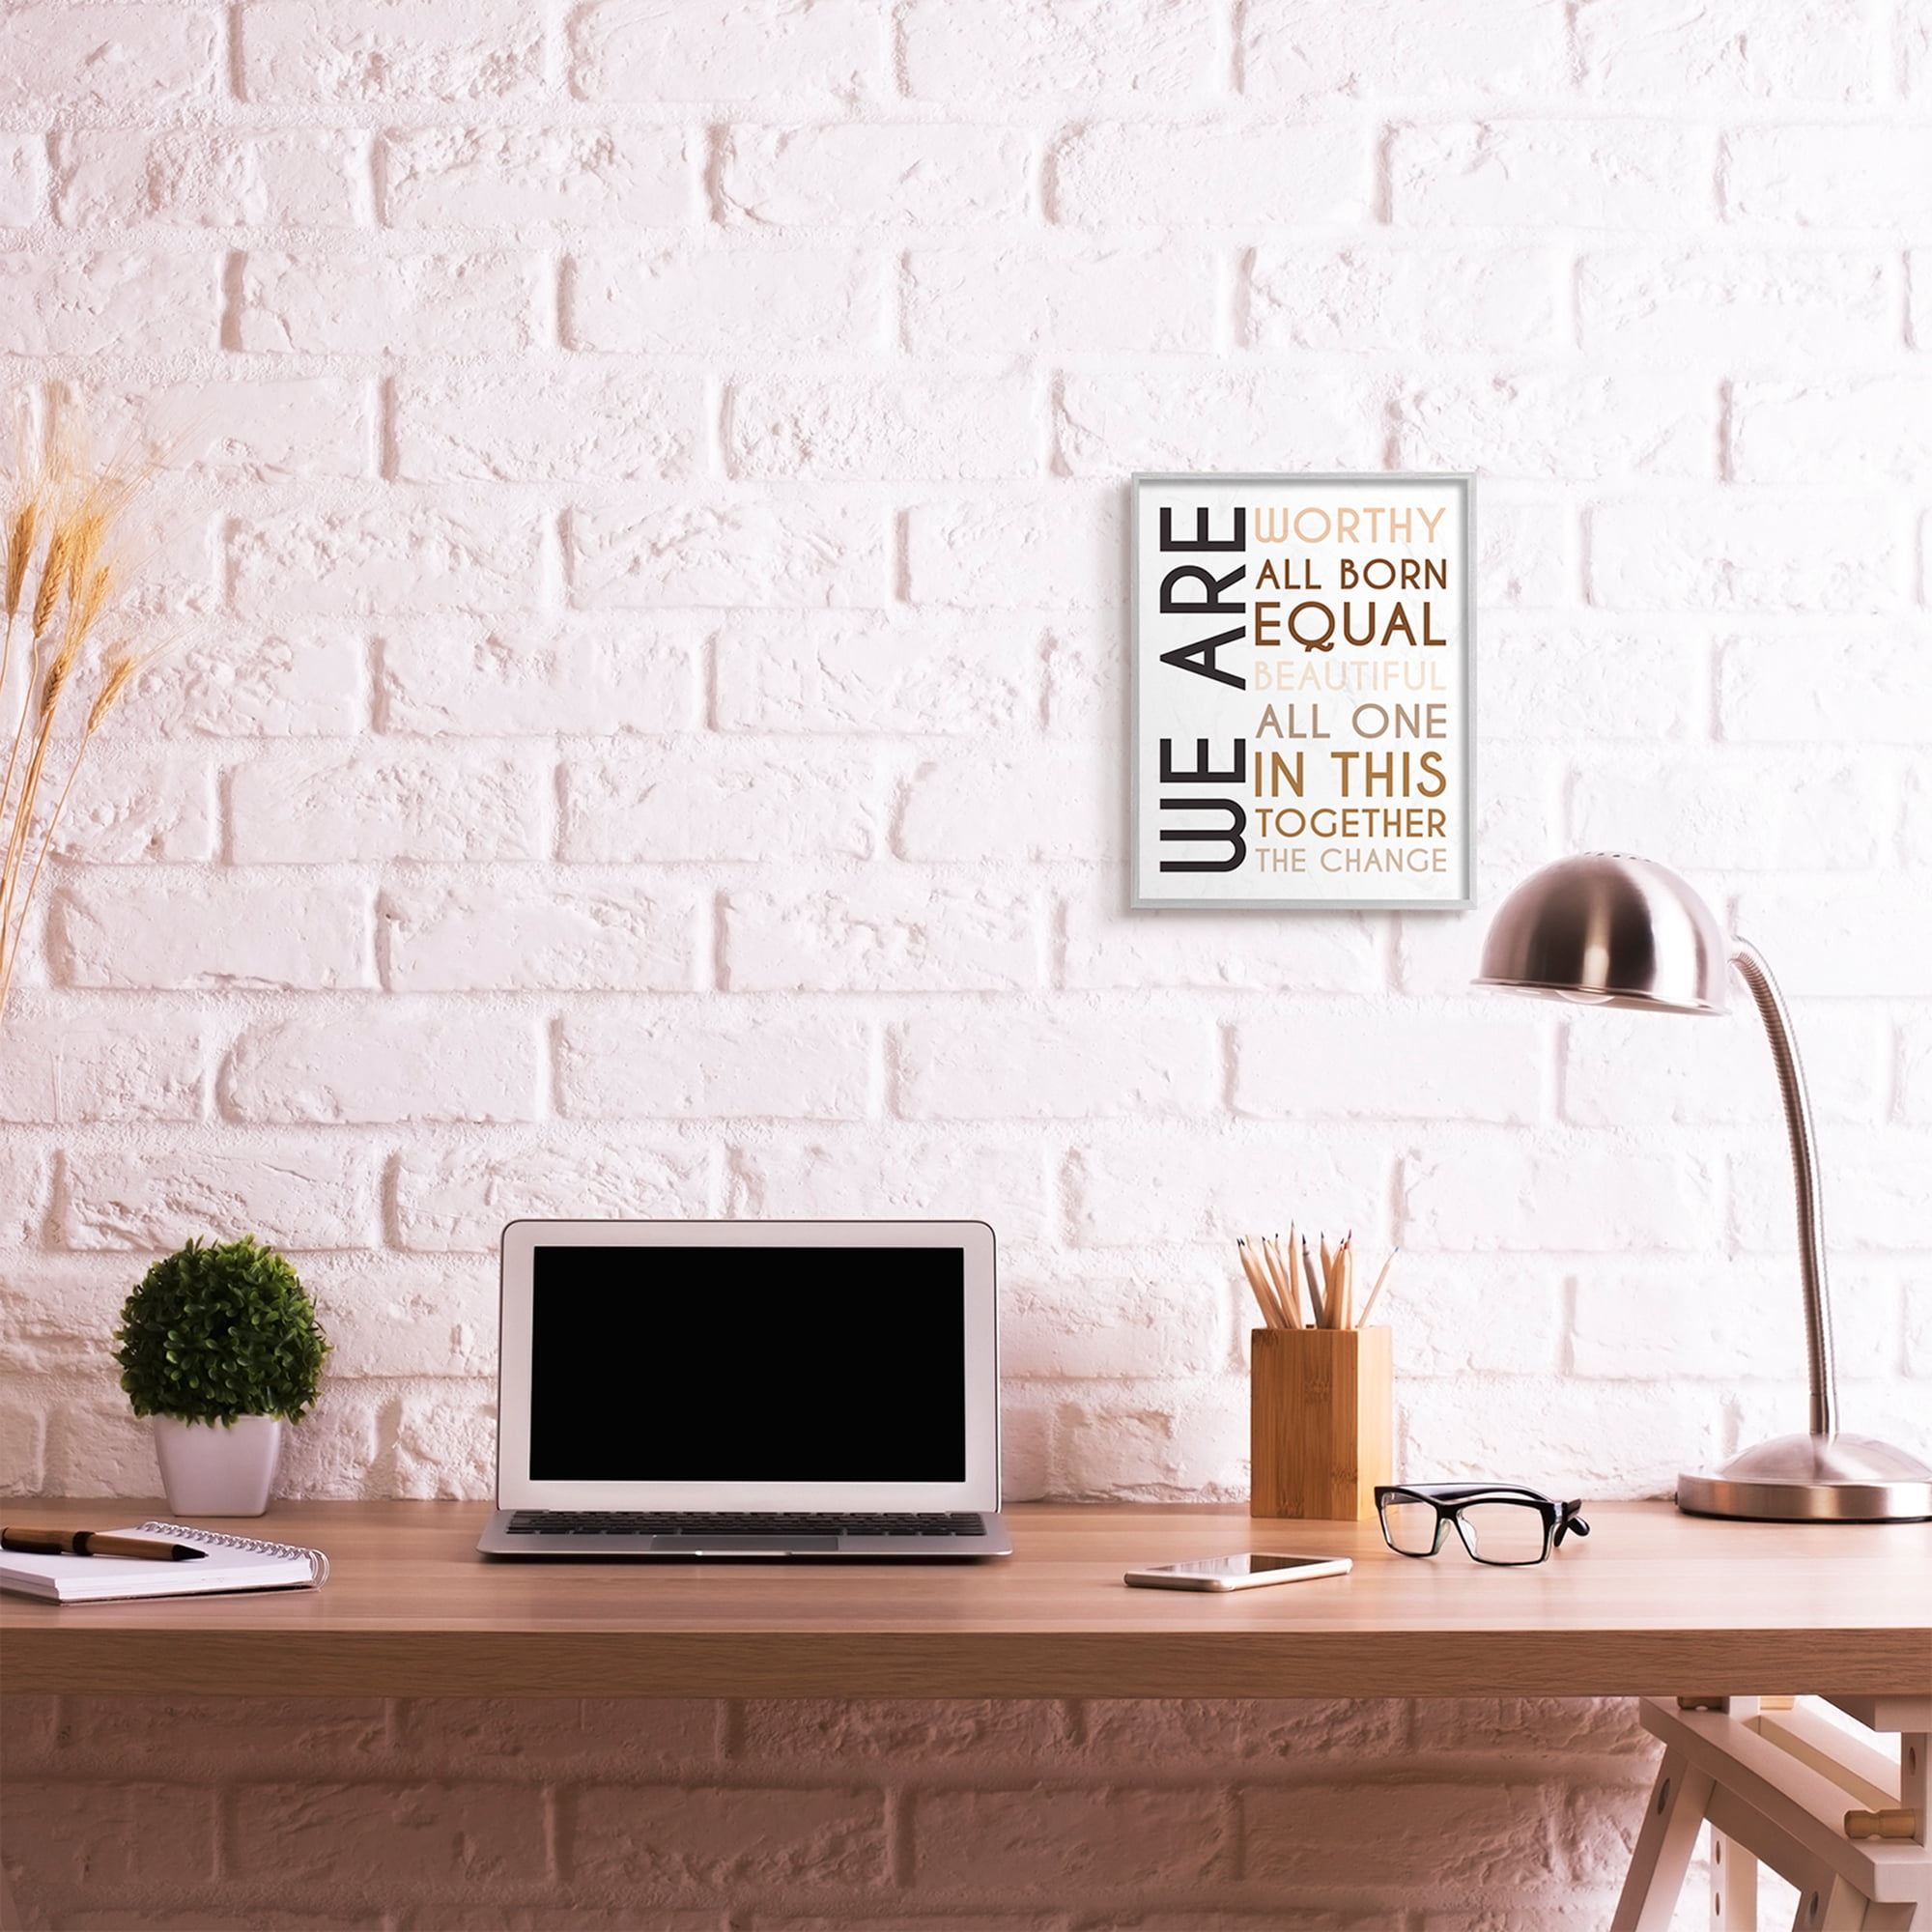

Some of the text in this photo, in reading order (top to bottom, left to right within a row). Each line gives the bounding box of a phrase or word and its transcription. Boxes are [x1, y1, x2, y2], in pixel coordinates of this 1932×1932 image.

[1254, 507, 1446, 544] WORTHY
[1255, 557, 1447, 590] ALL BORN
[1254, 600, 1447, 653] EQUAL
[1160, 507, 1246, 872] WE ARE
[1255, 661, 1445, 691] BEAUTIFUL
[1256, 703, 1447, 739] ALL ONE
[1254, 751, 1447, 798] IN THIS
[1254, 808, 1447, 838] TOGETHER
[1255, 848, 1446, 872] THE CHANGE
